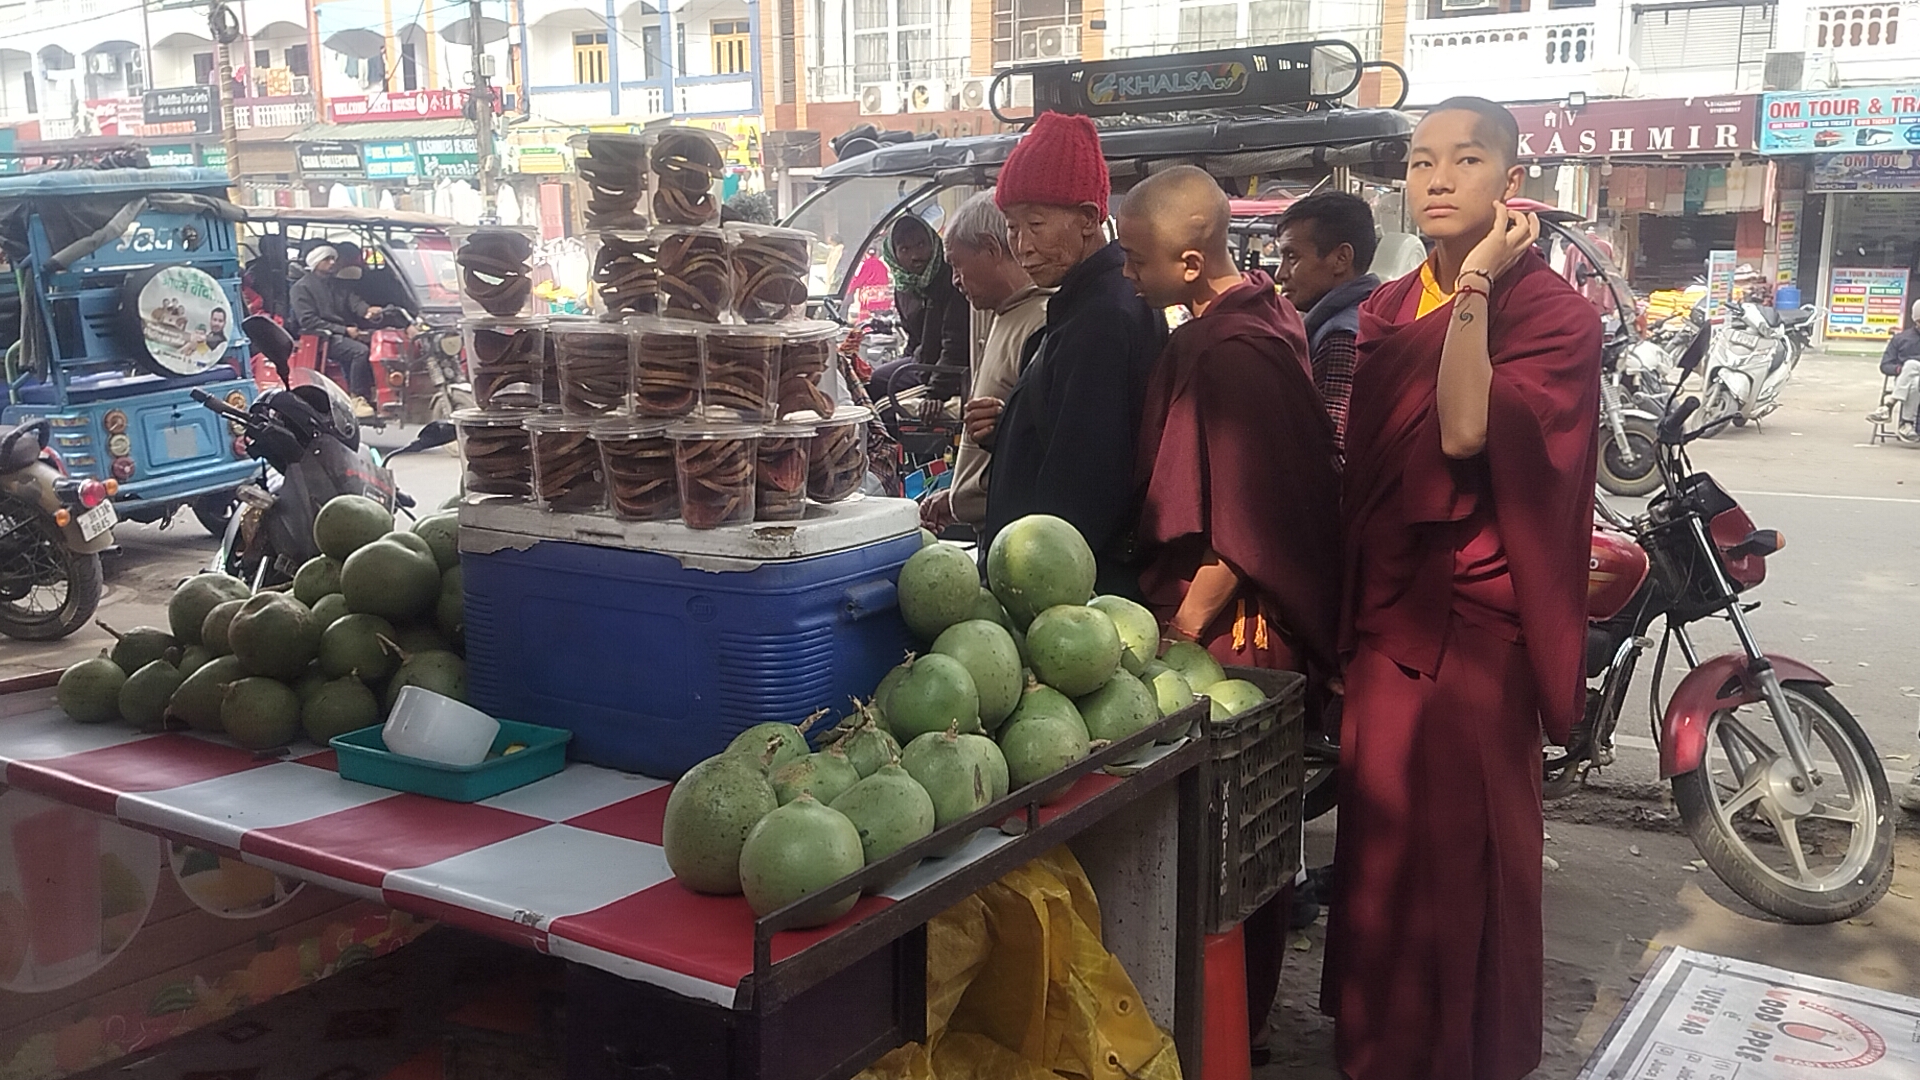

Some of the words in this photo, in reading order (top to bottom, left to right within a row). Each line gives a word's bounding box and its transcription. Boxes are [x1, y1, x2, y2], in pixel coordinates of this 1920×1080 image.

[1119, 71, 1213, 97] KHALSA
[1214, 77, 1234, 90] CV
[391, 98, 416, 112] HOUSE
[1769, 101, 1801, 119] OM
[1808, 98, 1860, 117] TOUR
[1867, 98, 1883, 115] &
[917, 114, 984, 140] Hotel
[1517, 124, 1740, 156] KASHMIR
[320, 154, 359, 168] COLLECTION
[1844, 156, 1868, 168] OM
[1872, 154, 1900, 168] TOU
[1690, 984, 1727, 1016] JUICE
[1754, 989, 1792, 1023] WOOD
[1677, 1013, 1711, 1035] BAR
[1734, 1021, 1775, 1063] APPLE
